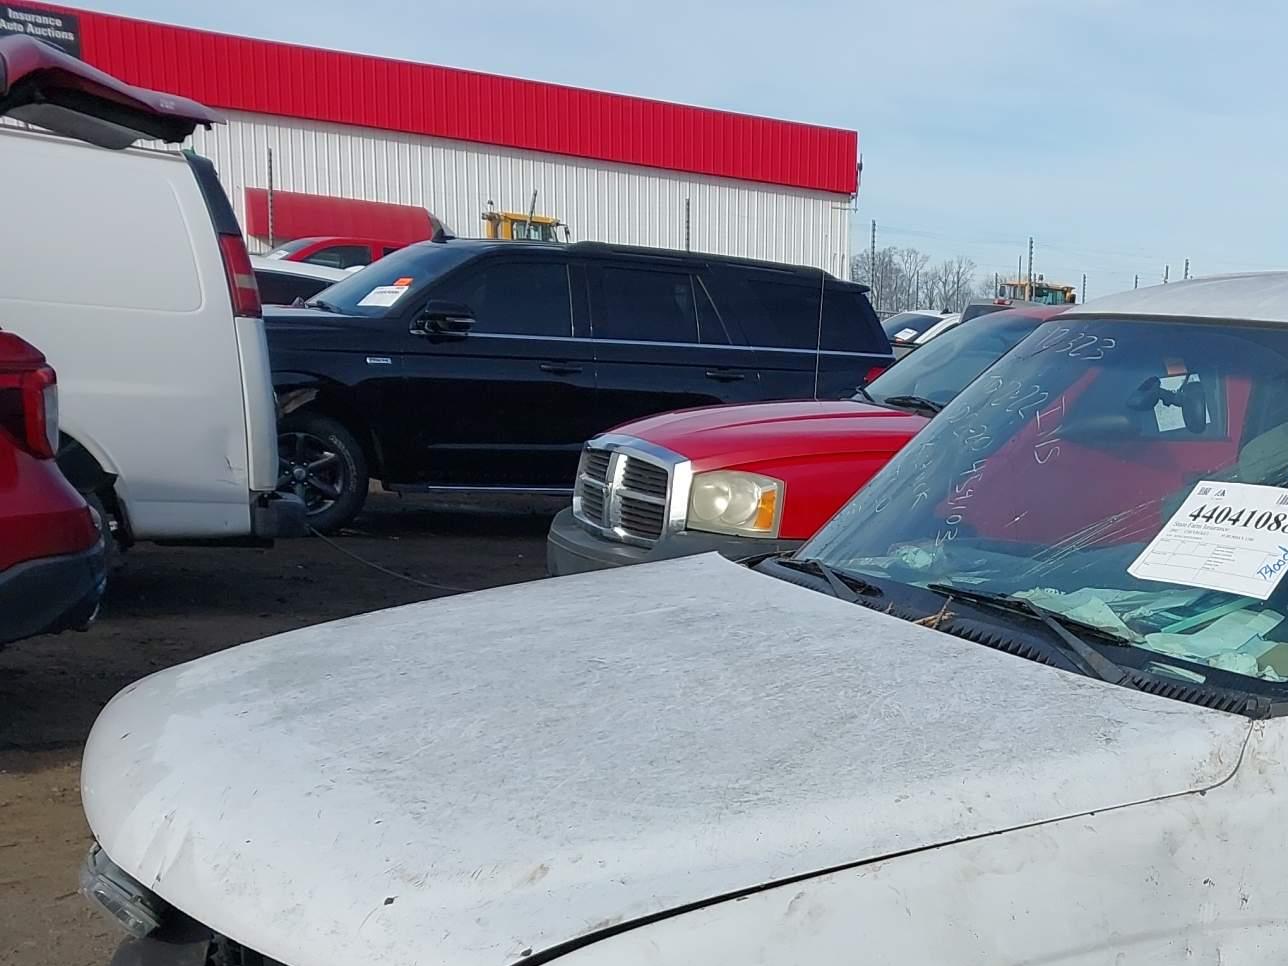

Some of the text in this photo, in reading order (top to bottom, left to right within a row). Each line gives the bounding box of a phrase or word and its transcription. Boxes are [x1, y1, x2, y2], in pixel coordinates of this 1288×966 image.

[8, 8, 62, 27] Insurance
[0, 18, 75, 40] Auto Auctions
